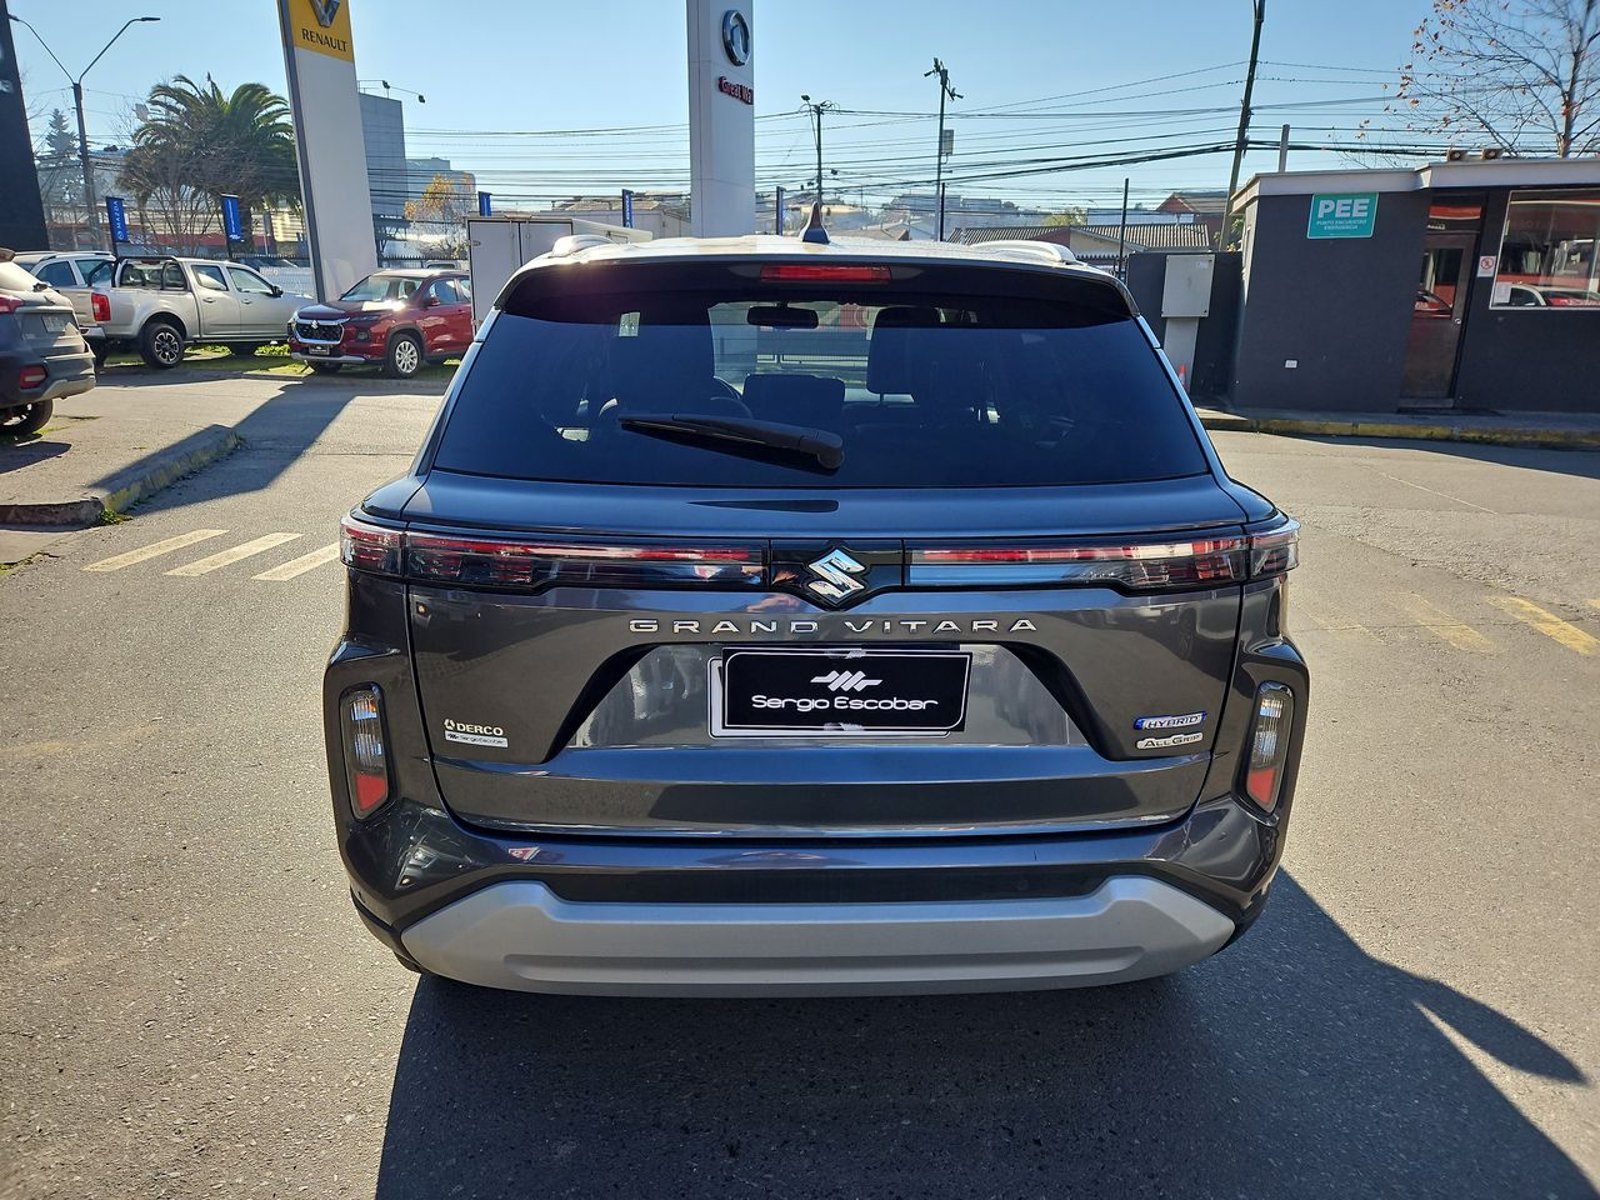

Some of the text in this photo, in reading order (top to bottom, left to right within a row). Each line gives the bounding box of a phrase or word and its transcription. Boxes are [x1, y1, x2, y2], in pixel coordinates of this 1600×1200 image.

[301, 28, 348, 52] RENAULT
[113, 200, 123, 229] MAZDA
[1317, 199, 1370, 218] PEE
[629, 619, 1037, 633] GRAND VITARA
[752, 695, 938, 712] Sergio Escobar
[456, 723, 504, 736] DERCO
[1147, 715, 1198, 728] HYBRID
